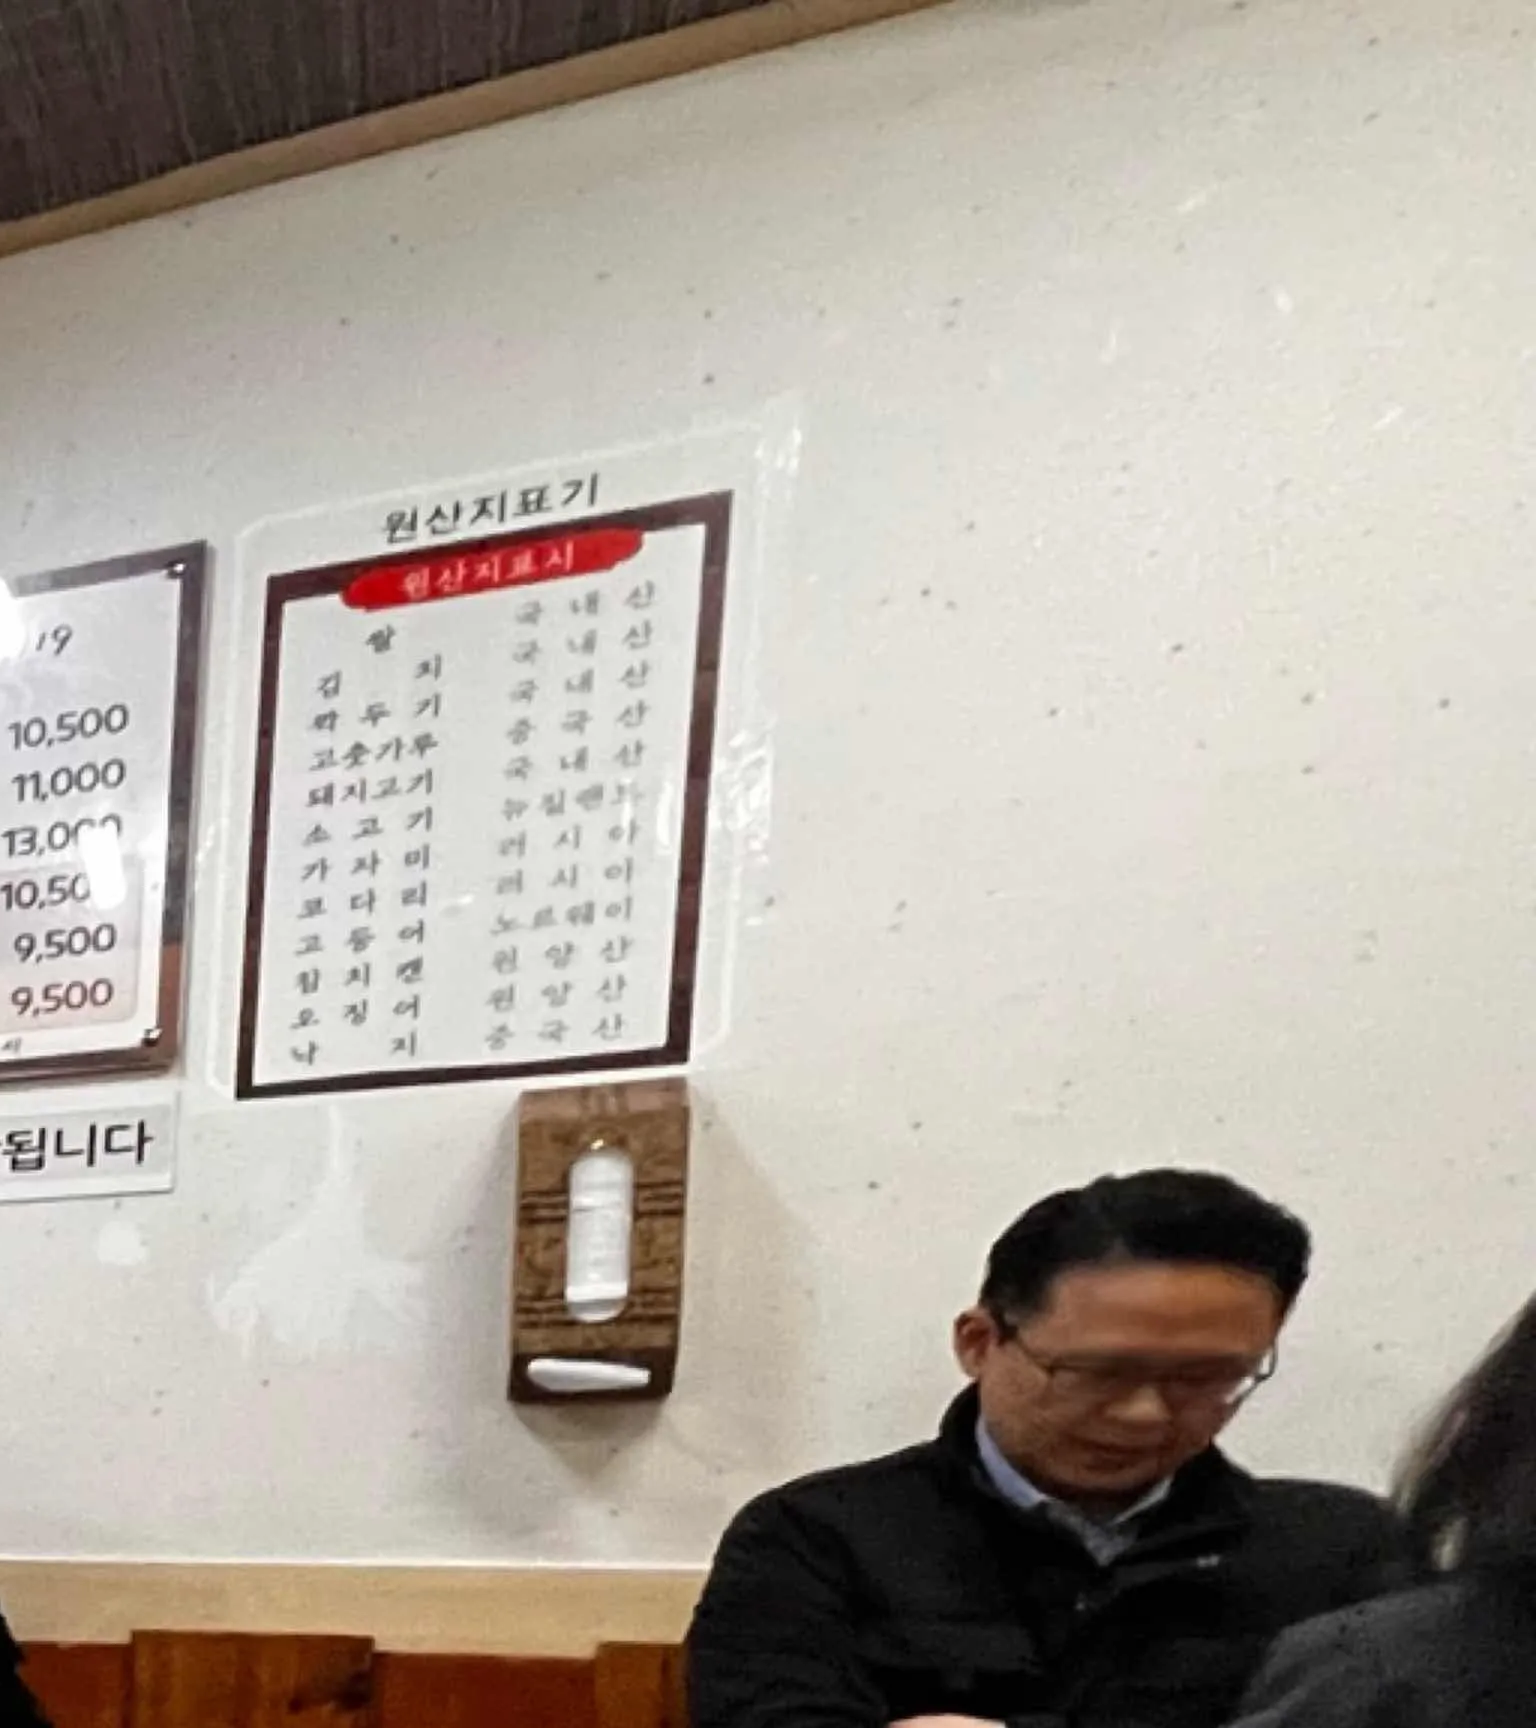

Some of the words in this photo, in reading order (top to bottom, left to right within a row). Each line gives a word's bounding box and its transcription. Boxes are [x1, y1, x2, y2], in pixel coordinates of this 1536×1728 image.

[384, 473, 600, 543] 원산지표기
[399, 541, 575, 601] 원산지표시
[8, 704, 129, 749] 10,500
[12, 758, 125, 802] 11,000
[14, 923, 116, 964] 9,500
[12, 978, 114, 1017] 9,500
